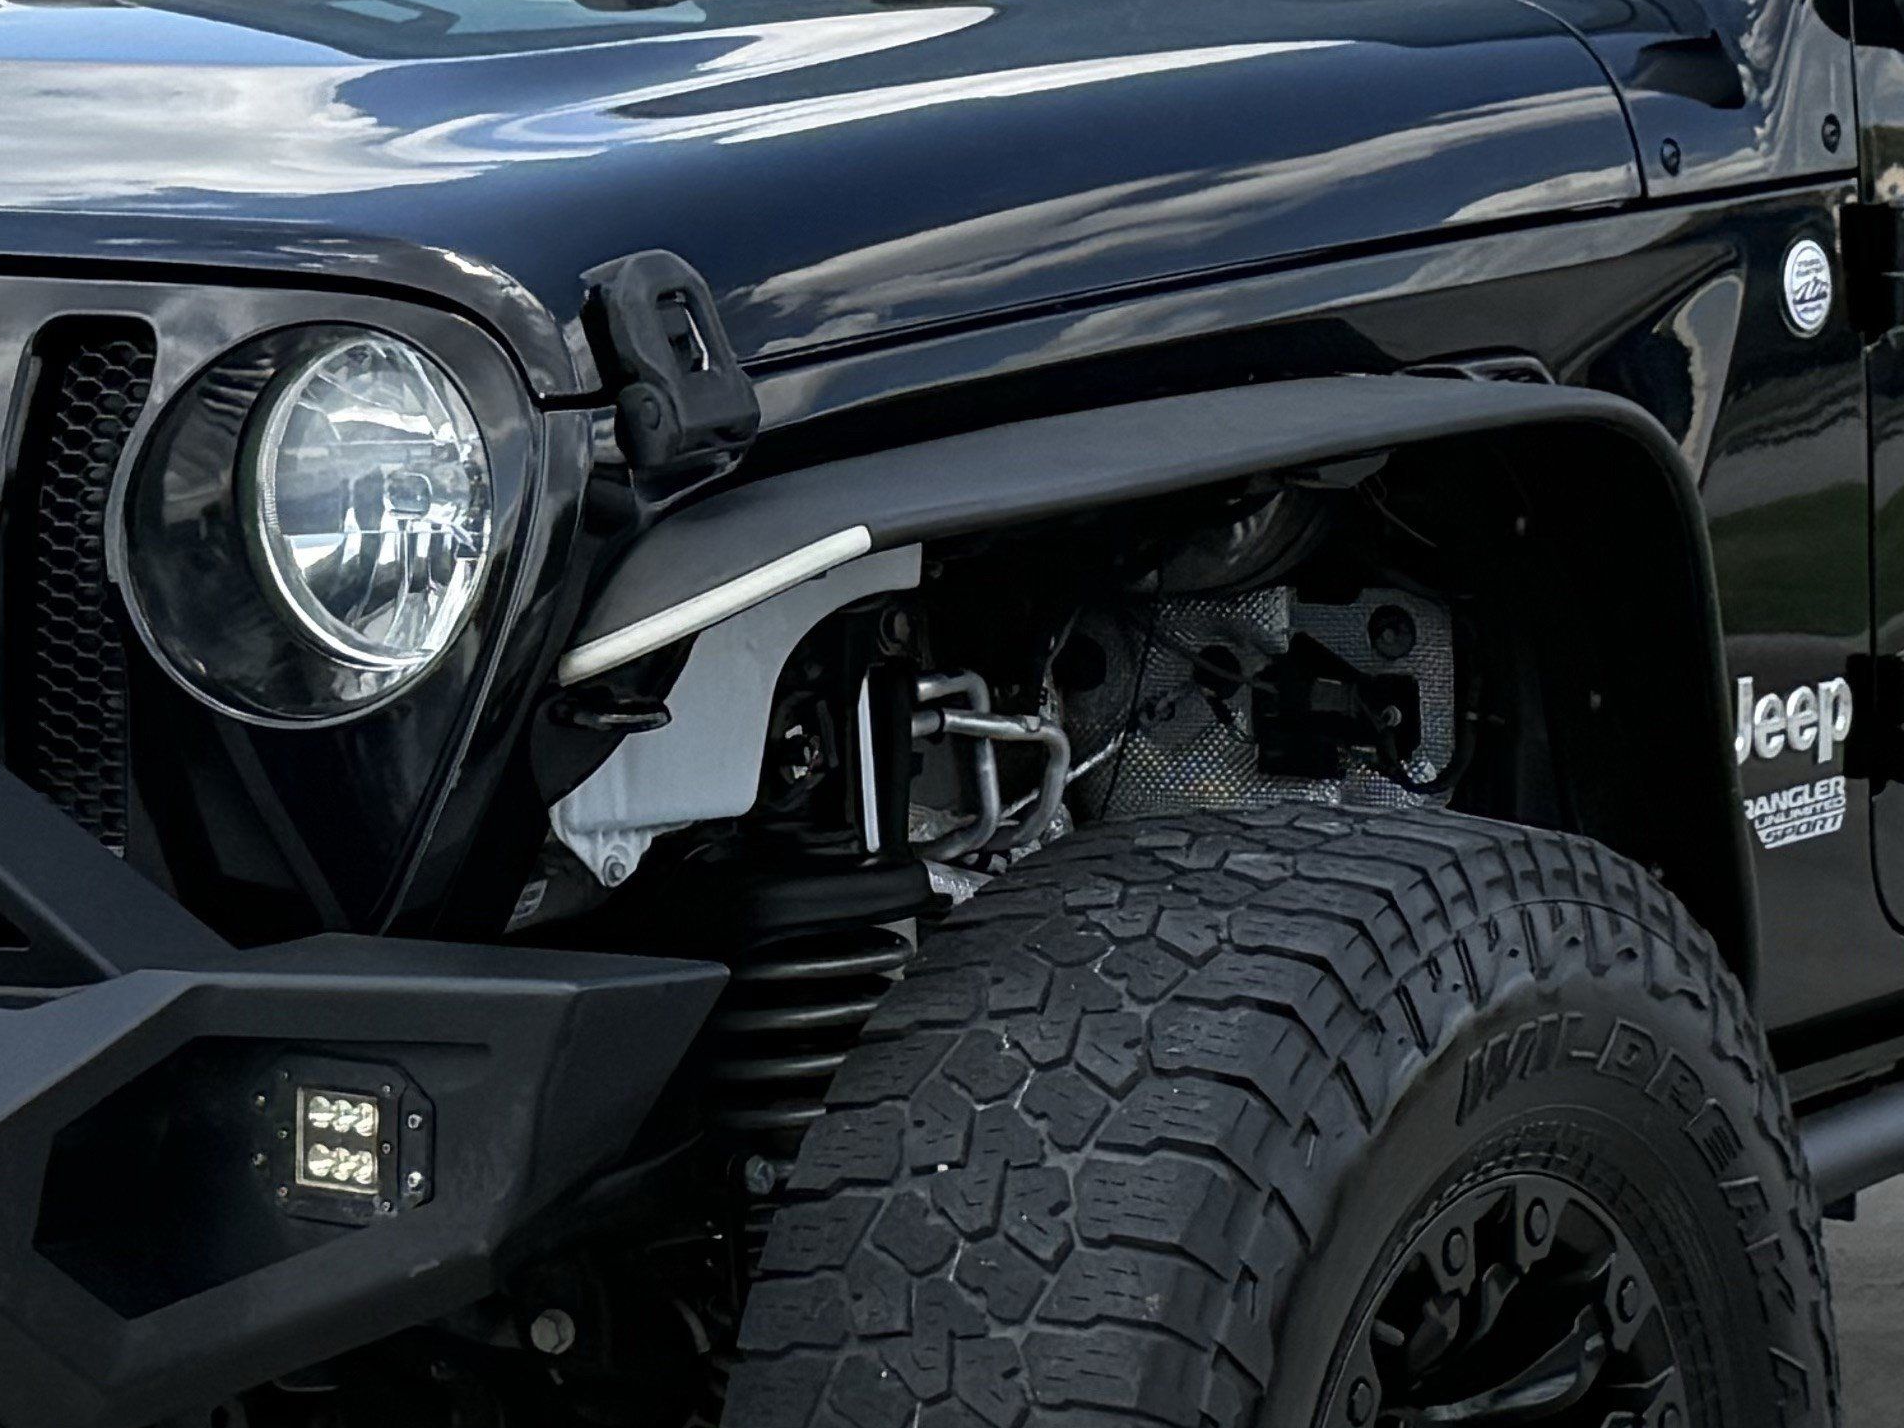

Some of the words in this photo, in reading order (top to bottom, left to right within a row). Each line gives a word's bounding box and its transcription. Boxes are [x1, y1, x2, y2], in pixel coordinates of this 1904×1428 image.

[1733, 675, 1854, 767] Jeep
[1764, 813, 1842, 842] SPORT
[1455, 1010, 1797, 1325] WILDPEAK
